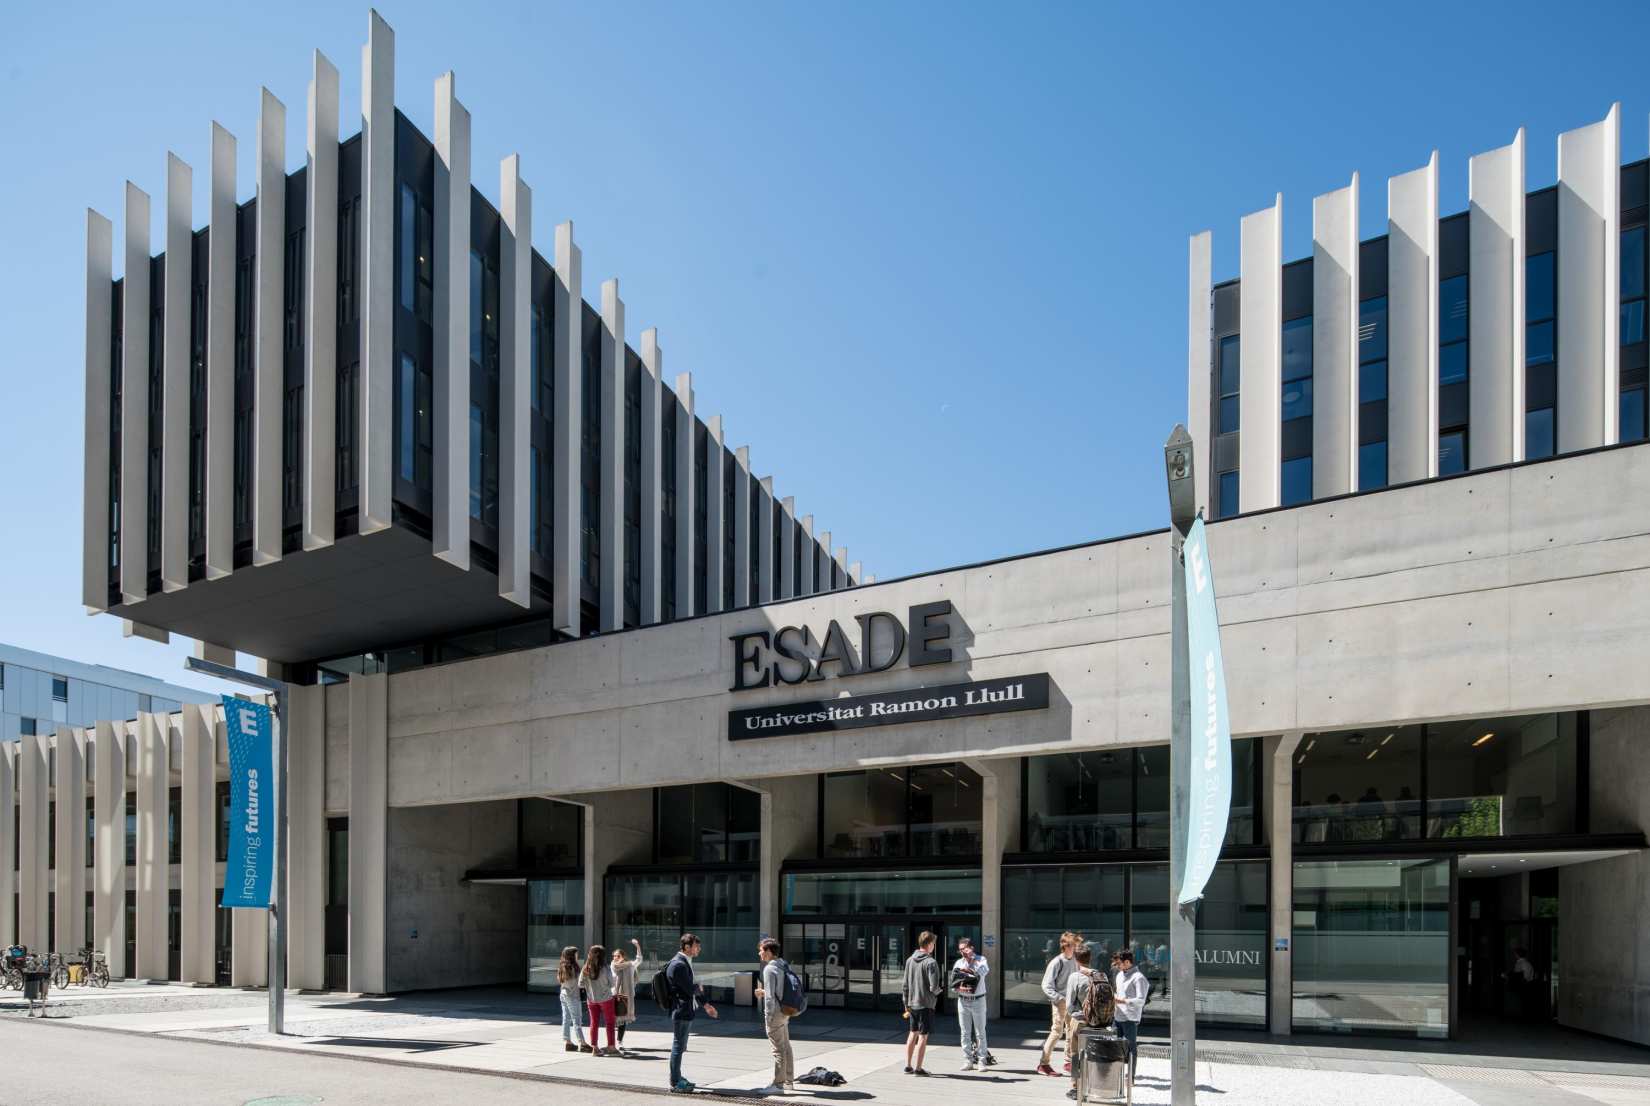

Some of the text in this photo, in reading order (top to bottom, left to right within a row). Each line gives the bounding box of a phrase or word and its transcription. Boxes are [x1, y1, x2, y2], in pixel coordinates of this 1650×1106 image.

[729, 600, 952, 691] ESADE
[744, 683, 1024, 730] Universitat Ramon Llull
[240, 768, 261, 899] inspiring futures
[1194, 949, 1261, 965] ALUMNI
